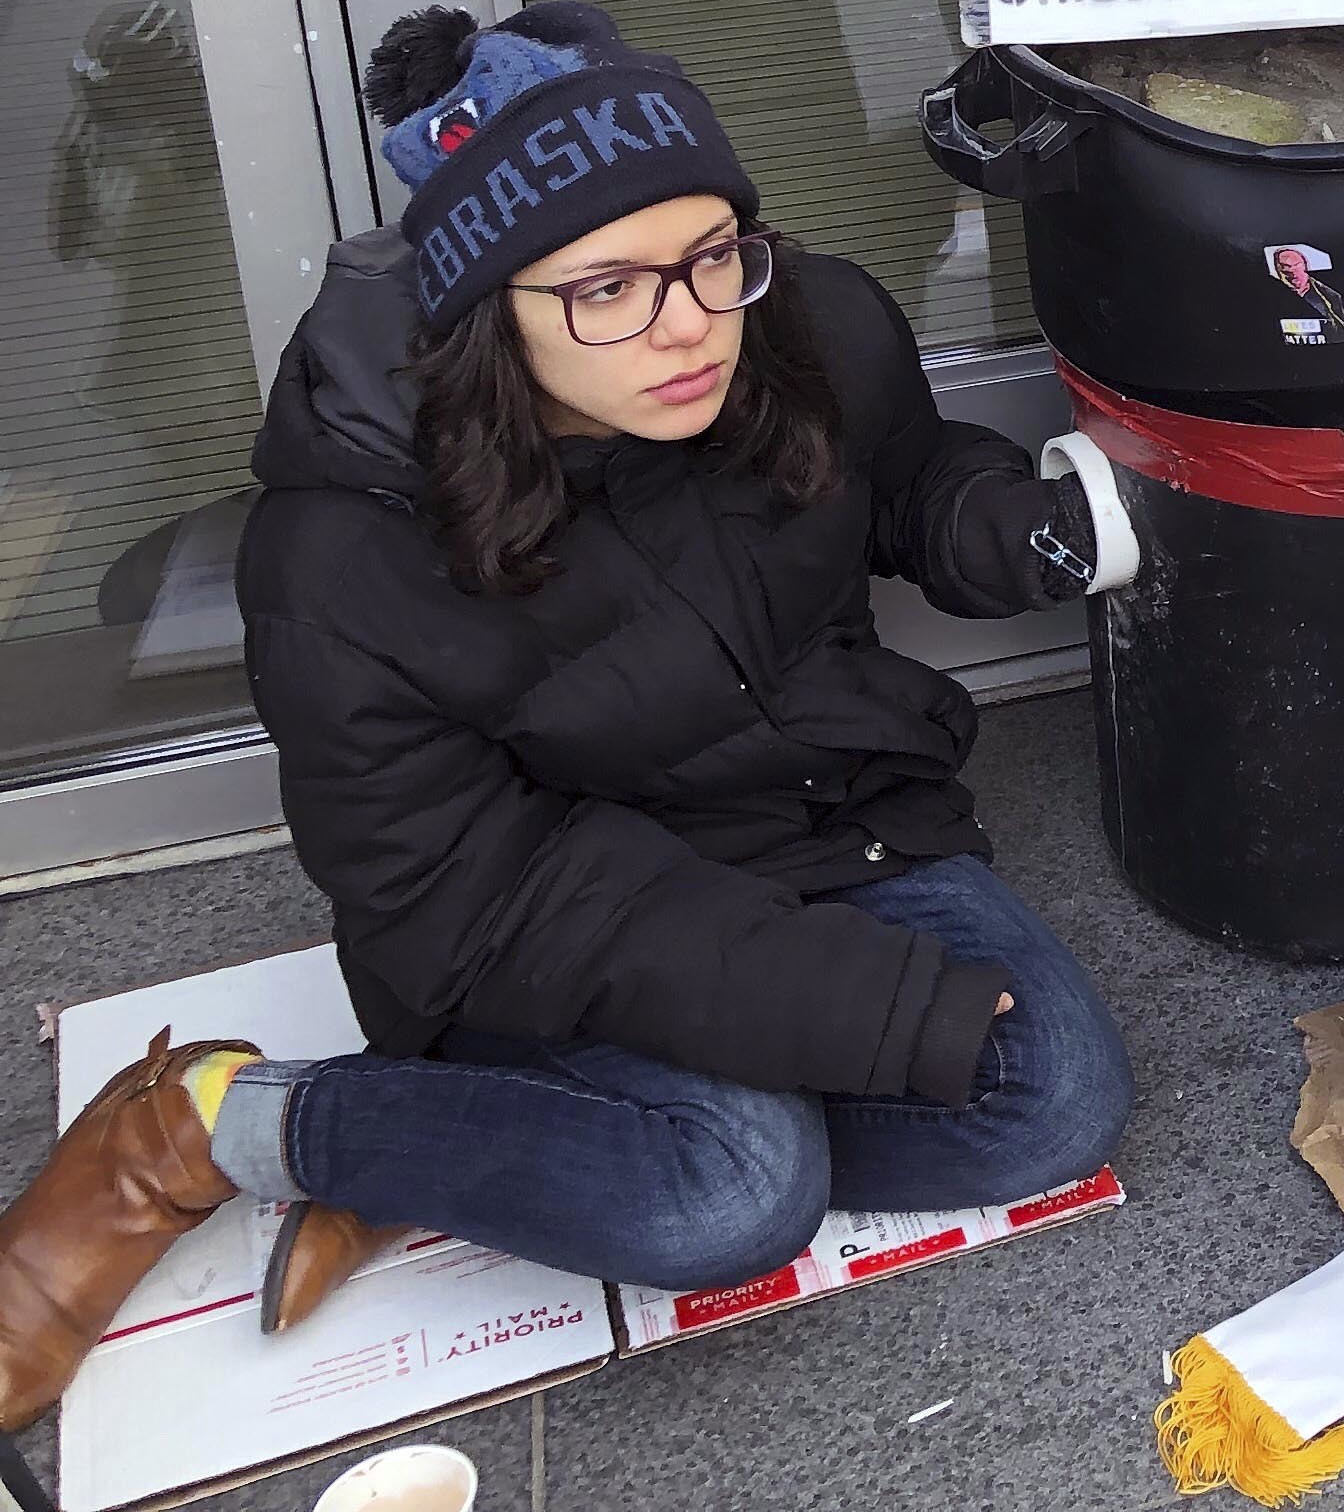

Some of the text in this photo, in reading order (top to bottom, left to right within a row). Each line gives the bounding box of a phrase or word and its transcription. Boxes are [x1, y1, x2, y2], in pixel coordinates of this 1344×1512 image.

[690, 1276, 780, 1310] PRIORITY
[712, 1295, 759, 1313] MAIL
[476, 1305, 549, 1331] MAIL
[446, 1309, 584, 1361] PRIORITY
